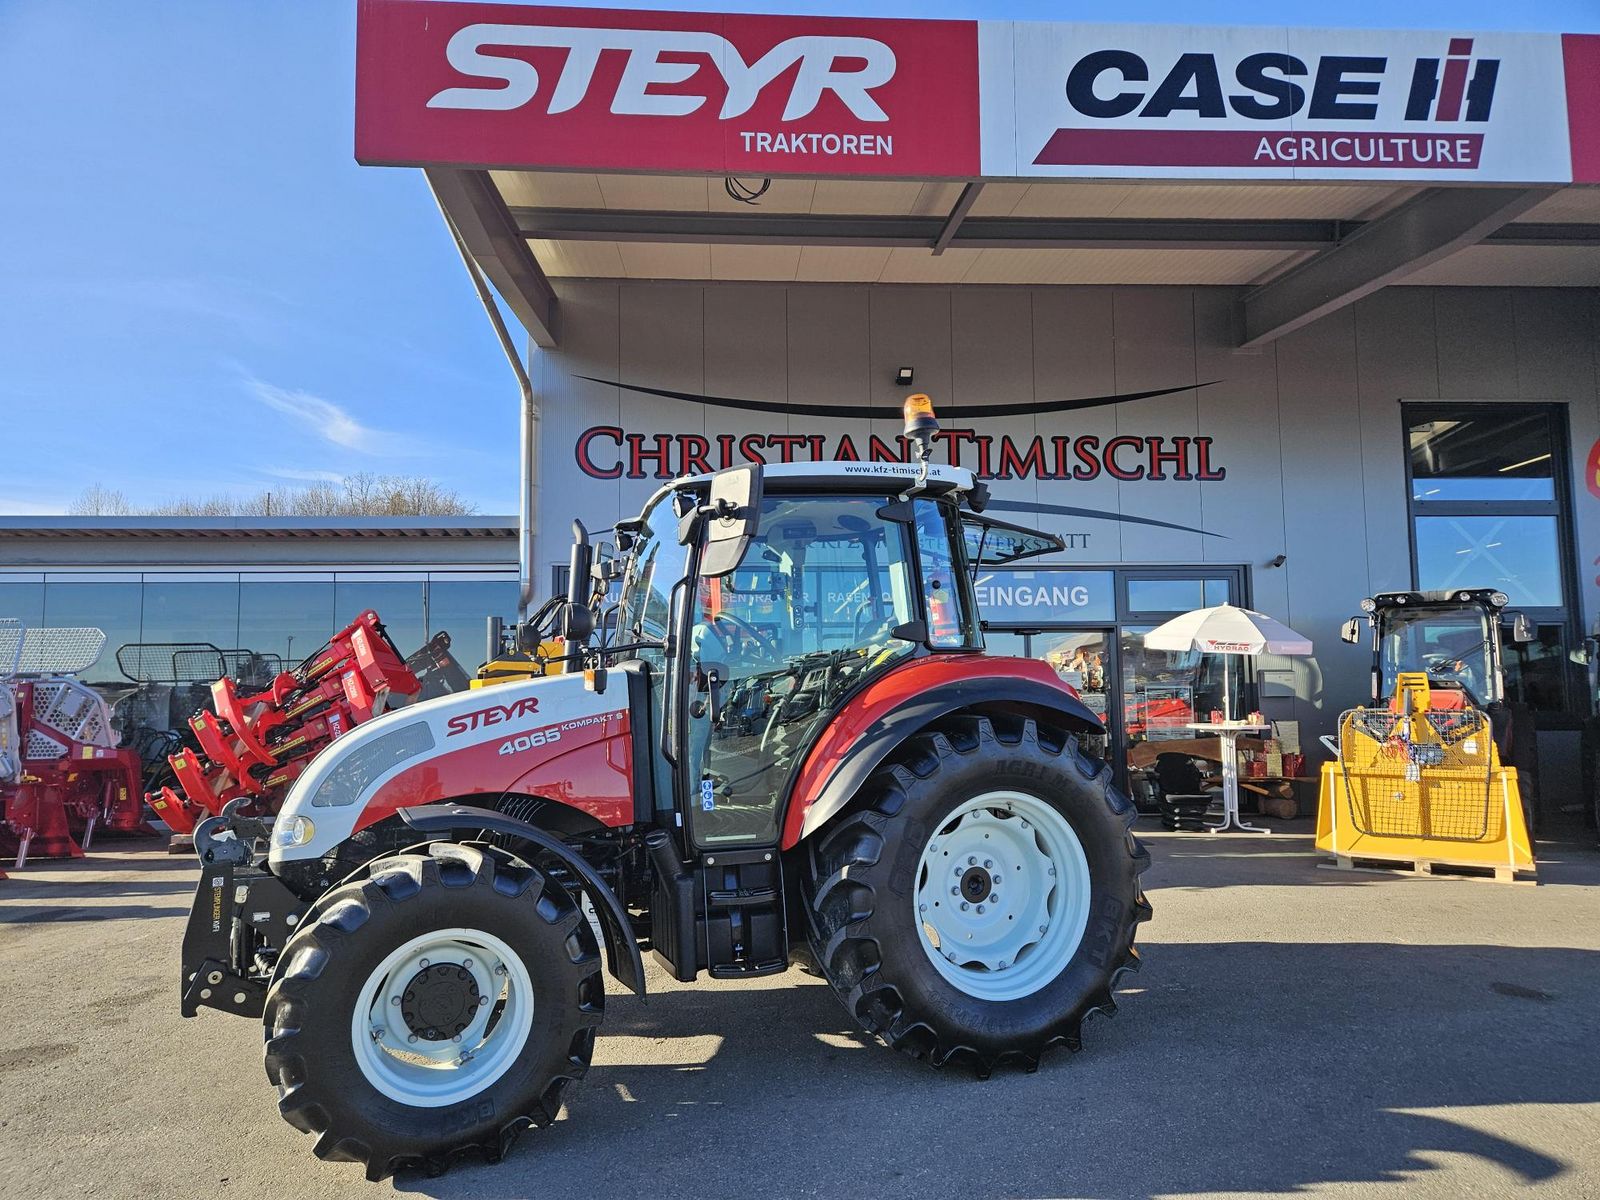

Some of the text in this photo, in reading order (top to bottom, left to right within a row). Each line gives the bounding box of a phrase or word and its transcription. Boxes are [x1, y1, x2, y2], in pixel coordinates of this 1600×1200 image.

[426, 23, 897, 122] STEYR
[1066, 49, 1387, 120] CASE
[740, 132, 894, 156] TRAKTOREN
[1254, 137, 1472, 163] AGRICULTURE
[932, 428, 1226, 481] TIMISCHL
[976, 586, 1089, 606] EINGANG
[446, 697, 540, 737] STEYR
[498, 712, 624, 756] 4065 KOMPAKT S
